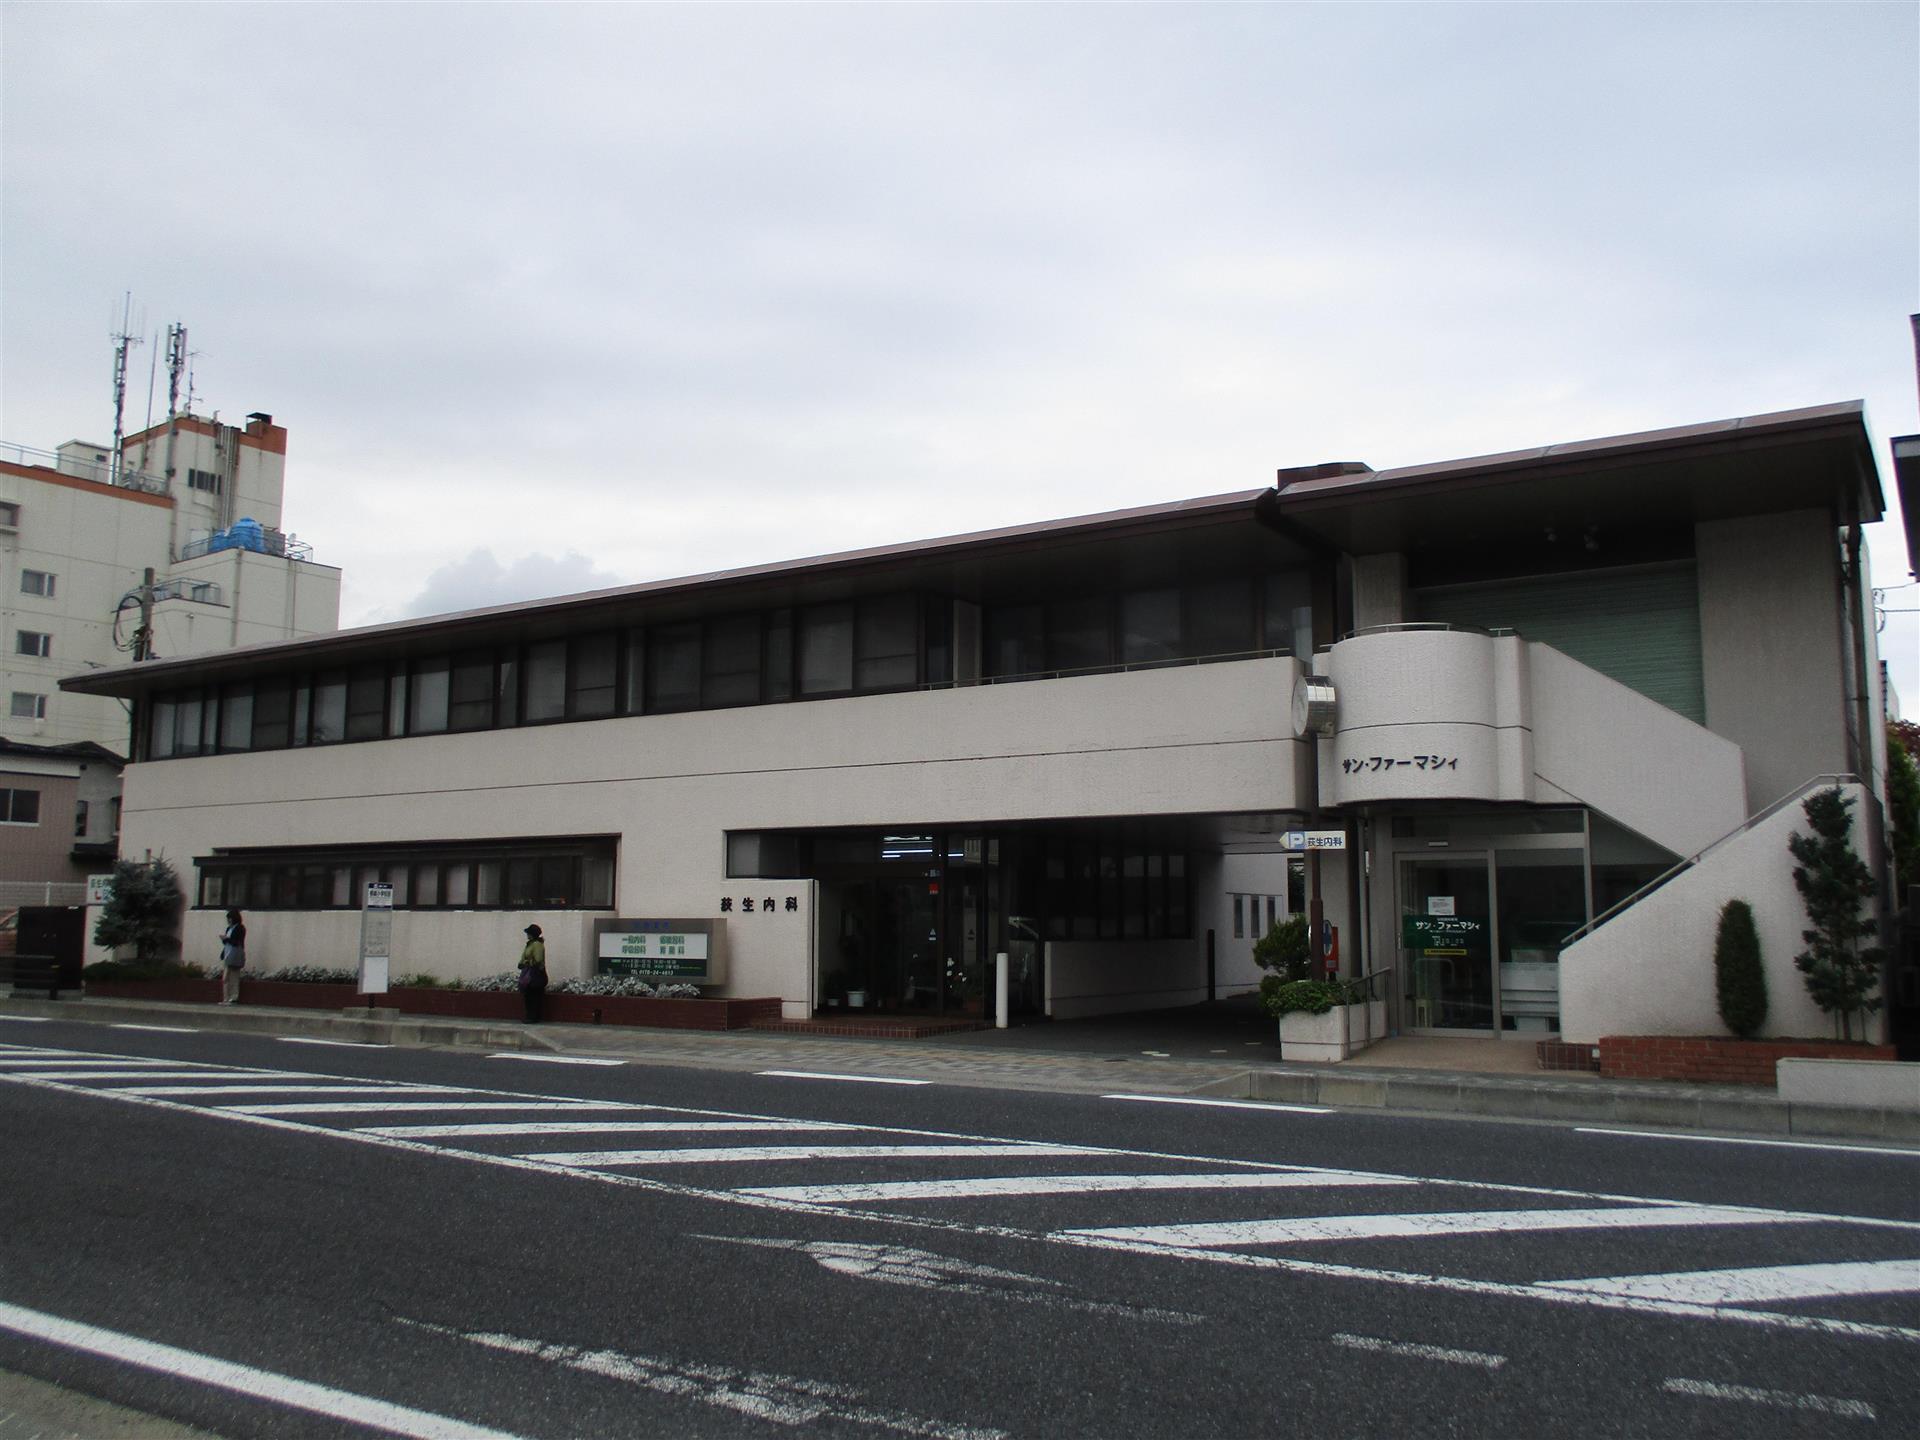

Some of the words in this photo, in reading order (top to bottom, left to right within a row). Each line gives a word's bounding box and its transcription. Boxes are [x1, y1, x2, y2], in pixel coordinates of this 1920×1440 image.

[1342, 755, 1458, 774] サン・ファーマシィ
[1289, 833, 1305, 848] P
